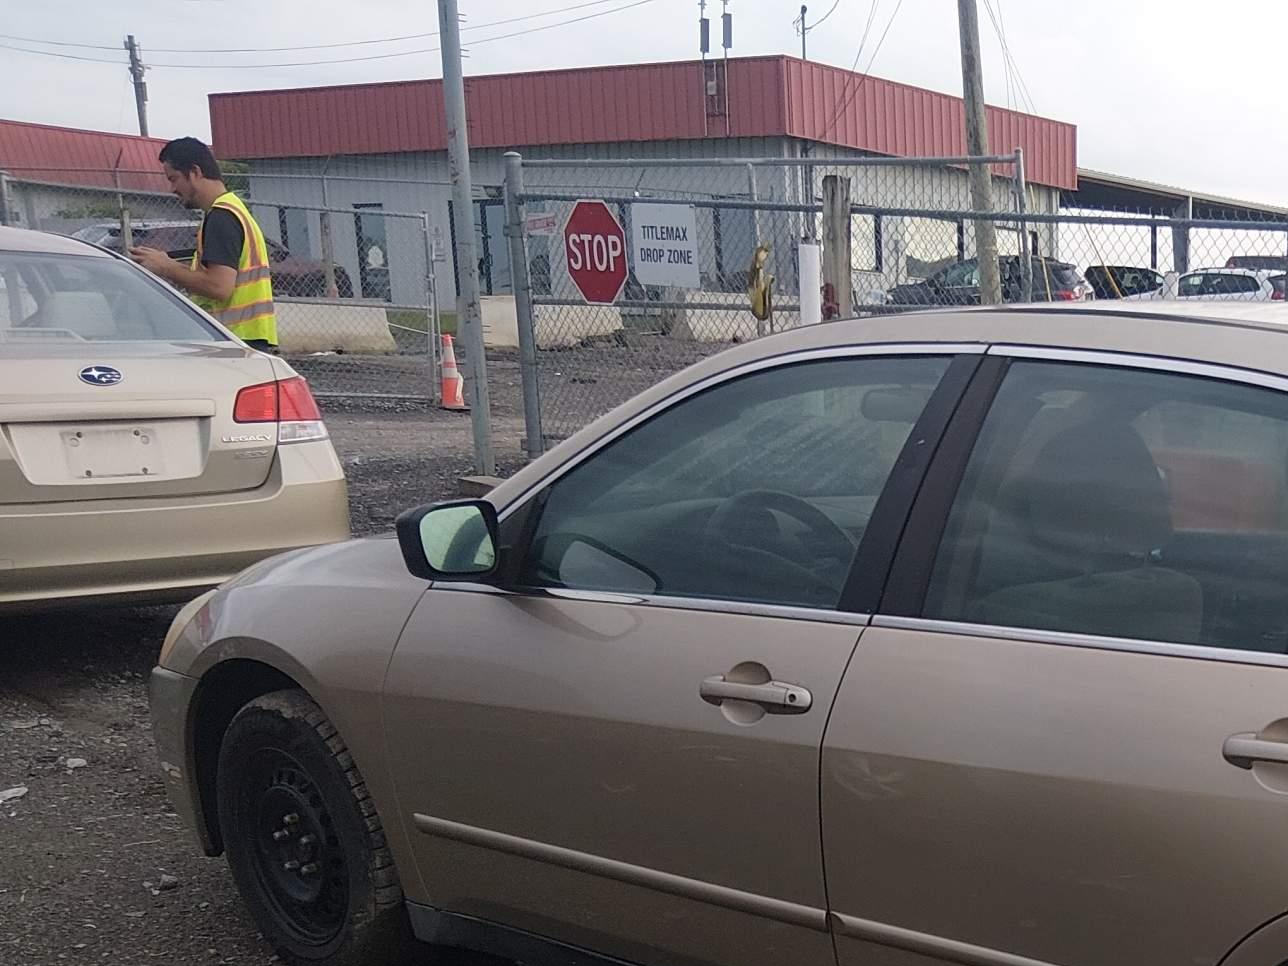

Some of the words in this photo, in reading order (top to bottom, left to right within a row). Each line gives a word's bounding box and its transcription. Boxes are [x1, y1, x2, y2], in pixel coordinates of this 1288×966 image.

[641, 225, 688, 241] TITLEMAX
[568, 233, 621, 272] STOP
[640, 247, 664, 263] DROP
[666, 249, 693, 265] ZONE
[221, 433, 272, 443] LEGACY
